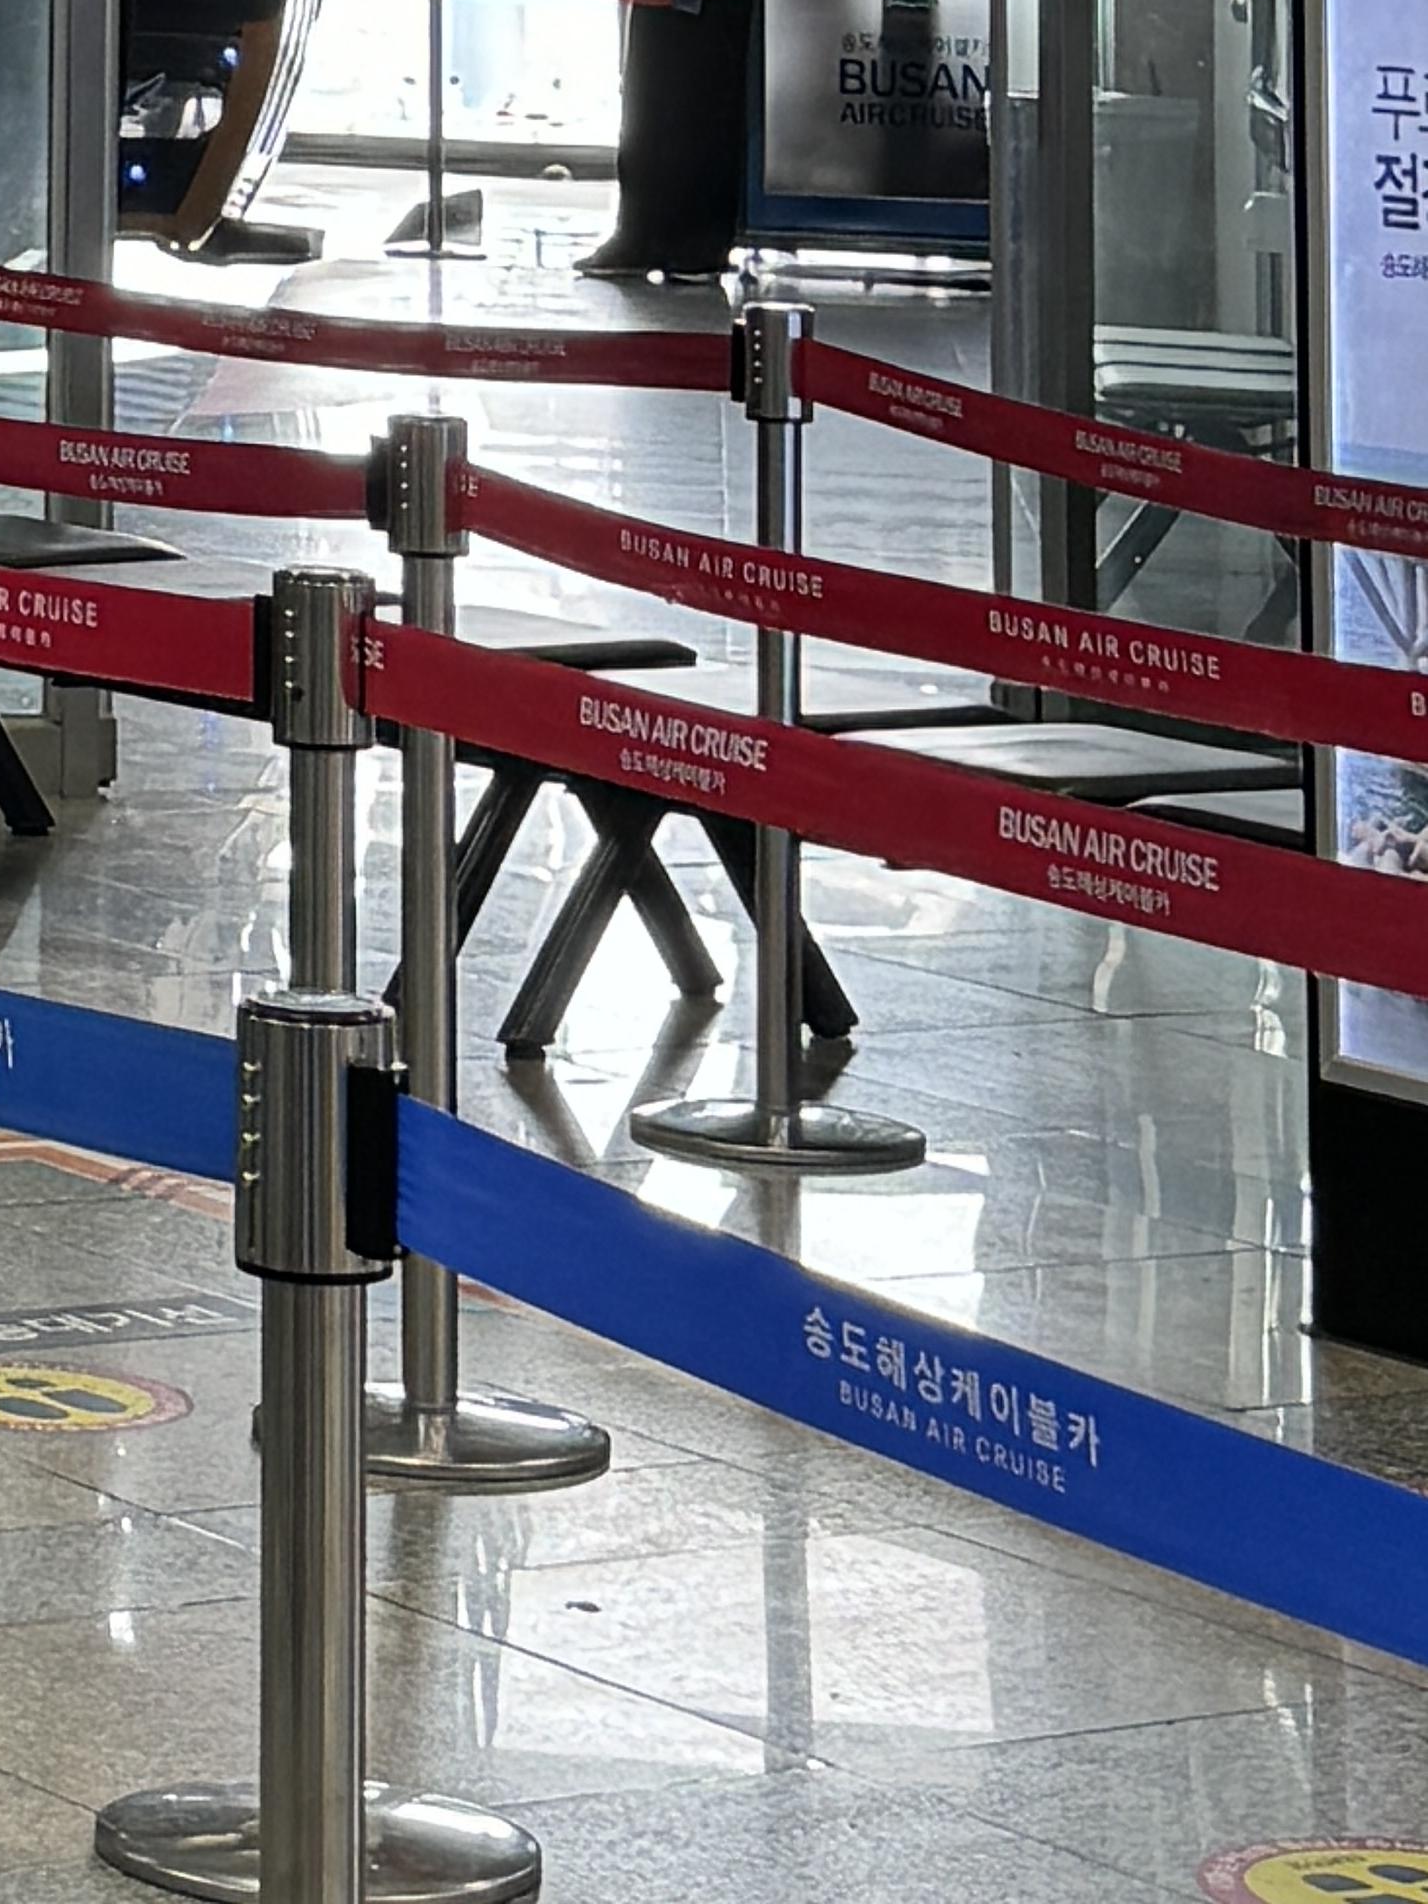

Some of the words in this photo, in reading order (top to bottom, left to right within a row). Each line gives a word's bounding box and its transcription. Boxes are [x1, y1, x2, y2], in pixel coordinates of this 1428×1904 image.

[840, 58, 990, 100] BUSAN
[620, 529, 689, 568] BUSAN
[699, 552, 733, 580] AIR
[743, 562, 823, 598] CRUISE
[18, 590, 98, 628] CRUISE
[989, 610, 1069, 648] BUSAN
[1078, 631, 1119, 660] AIR
[1130, 639, 1221, 680] CRUISE
[580, 696, 650, 741] BUSAN
[651, 715, 689, 750] AIR
[691, 724, 768, 771] CRUISE
[999, 806, 1080, 856] BUSAN
[1084, 828, 1125, 868] AIR
[1130, 839, 1220, 891] CRUISE
[804, 1306, 1100, 1467] 송도해상케이블카
[840, 1380, 917, 1431] BUSAN
[926, 1418, 966, 1454] AIR
[976, 1436, 1066, 1494] CRUISE
